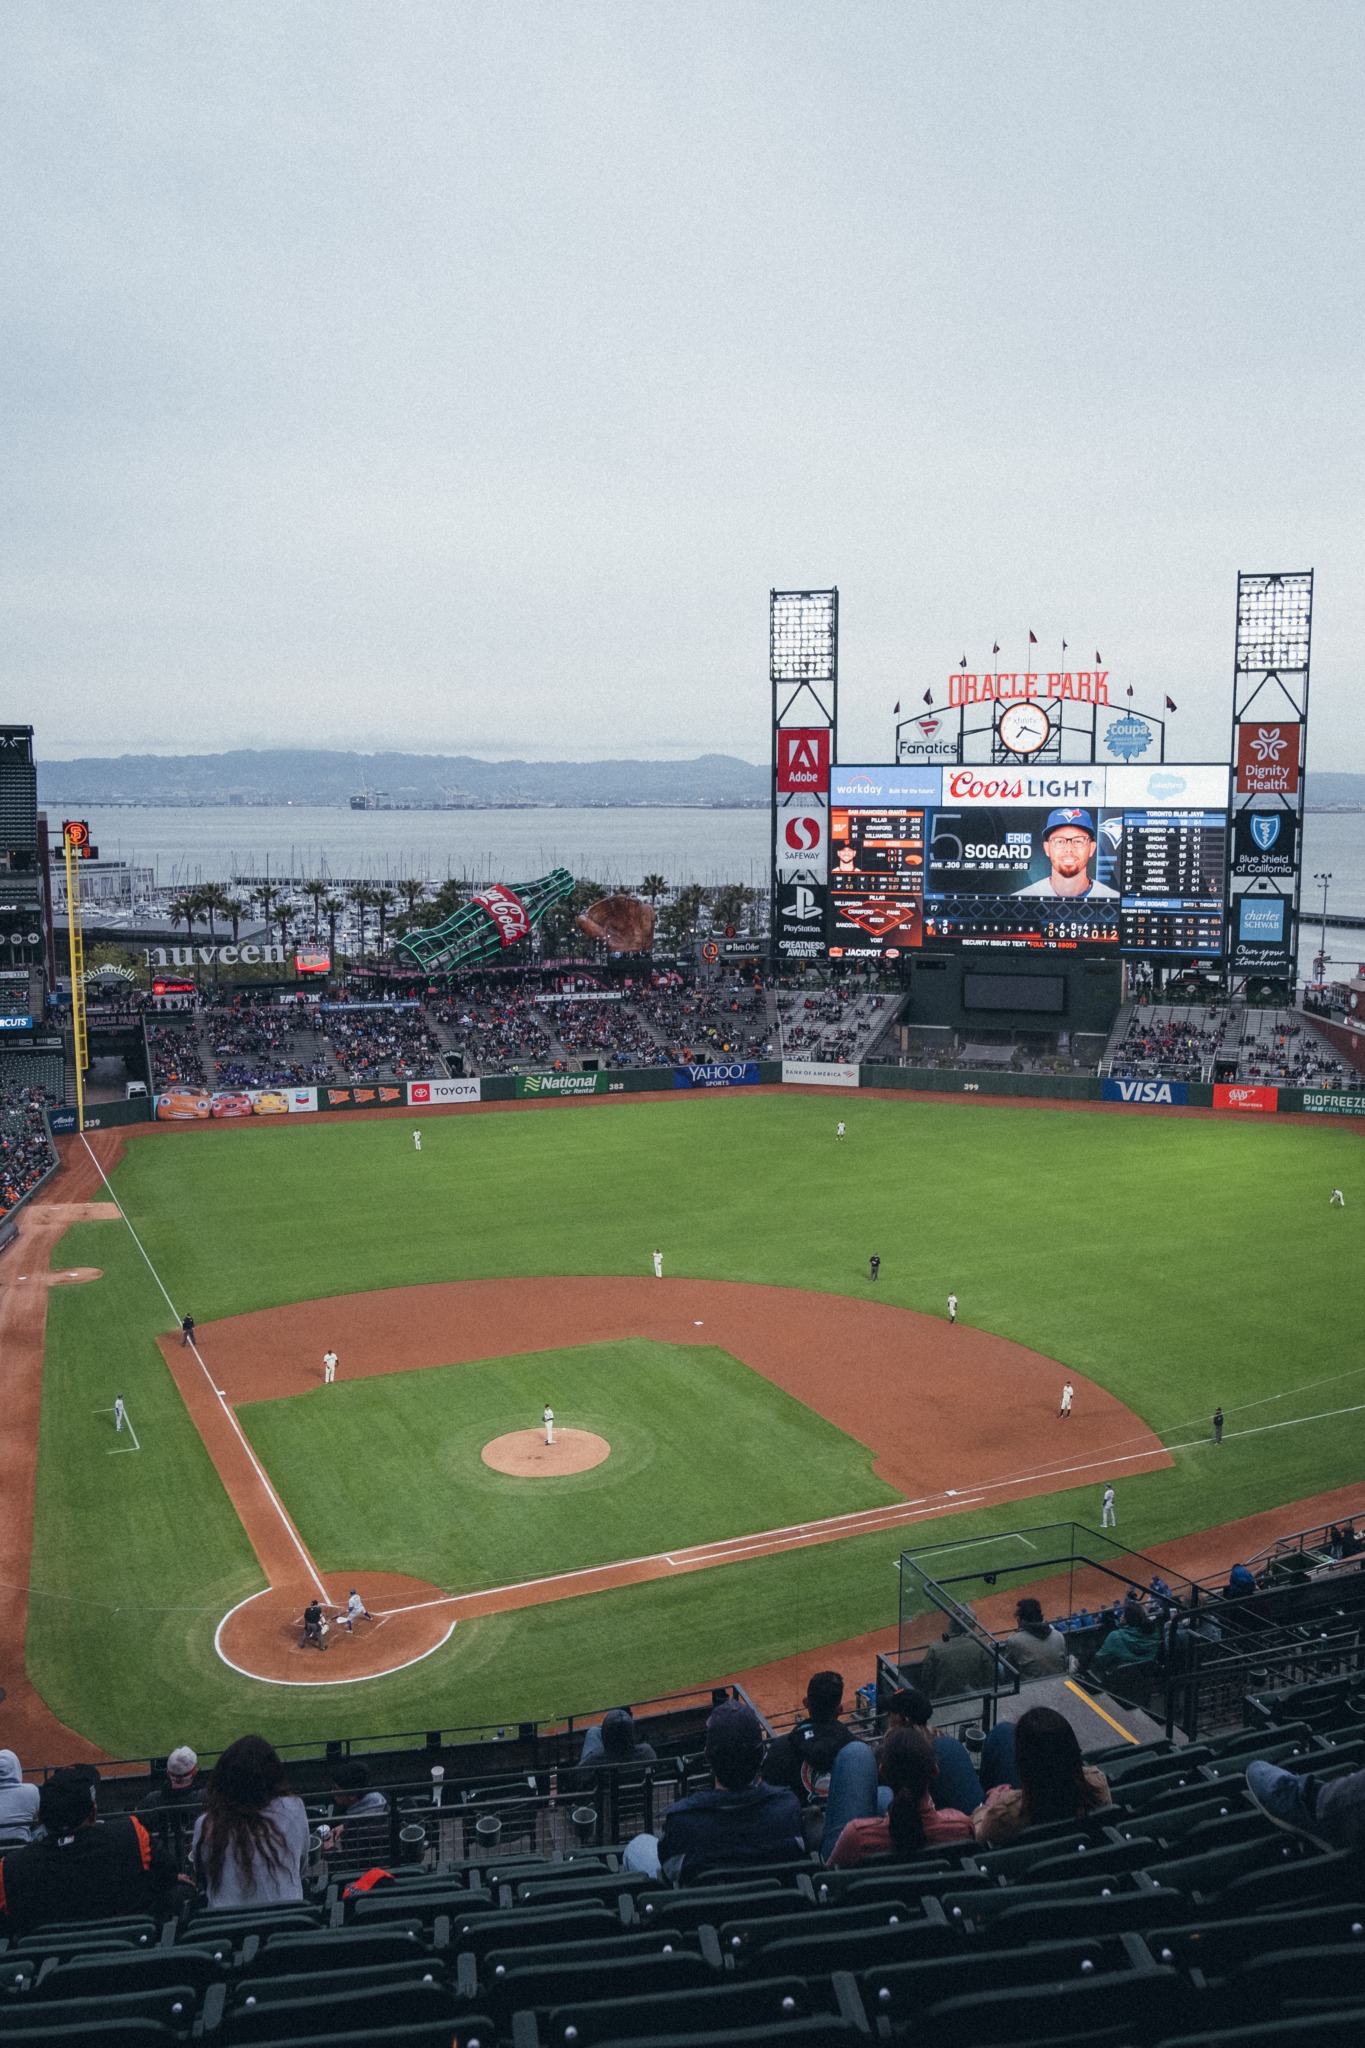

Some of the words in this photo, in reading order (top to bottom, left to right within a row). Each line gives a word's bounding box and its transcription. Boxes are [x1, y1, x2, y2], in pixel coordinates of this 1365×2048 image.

[949, 673, 1038, 708] ORACLE
[1046, 671, 1110, 707] PARK
[1013, 717, 1037, 726] xfinity
[1111, 725, 1148, 737] coupa
[900, 741, 958, 754] Fanatics
[789, 771, 818, 782] Adobe
[1245, 765, 1289, 778] Dignity
[837, 784, 882, 796] workday
[950, 771, 1024, 798] Coors
[1027, 780, 1092, 797] LIGHT
[1247, 779, 1288, 790] Health
[930, 814, 963, 860] 5
[1007, 834, 1031, 843] ERIC
[785, 852, 820, 860] SAFEWAY
[964, 844, 1032, 859] SOGARD
[1240, 855, 1259, 864] Blue
[1261, 855, 1288, 864] Shield
[1236, 864, 1246, 872] of
[1248, 864, 1292, 873] California
[1244, 910, 1280, 920] charles
[784, 925, 820, 934] PlayStation
[1092, 930, 1098, 939] 0
[1102, 931, 1106, 939] 1
[1110, 931, 1118, 940] 2
[779, 940, 826, 950] GREATNESS
[144, 944, 286, 967] nuveen
[1259, 950, 1284, 960] your
[1235, 957, 1286, 966] tomorrow
[82, 963, 138, 983] Ghirardelli
[688, 1064, 746, 1082] YAHOO!
[541, 1074, 597, 1090] National
[434, 1086, 477, 1096] TOYOTA
[1115, 1081, 1172, 1103] VISA
[52, 1116, 74, 1124] Alaska
[84, 1119, 100, 1128] 339
